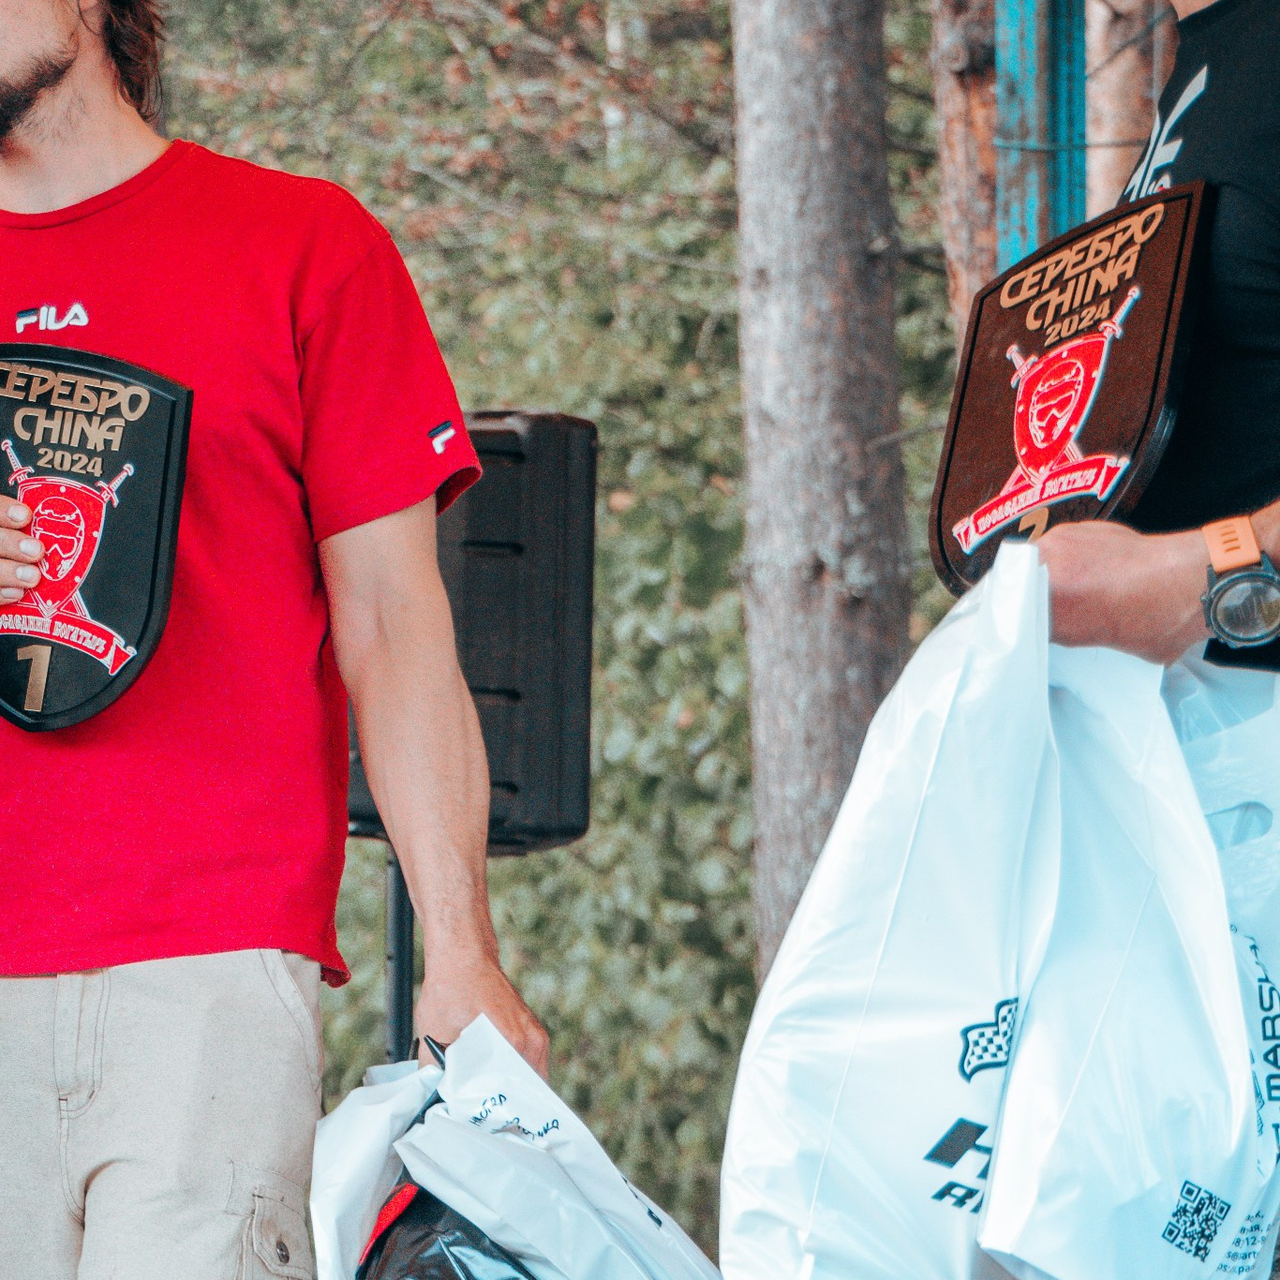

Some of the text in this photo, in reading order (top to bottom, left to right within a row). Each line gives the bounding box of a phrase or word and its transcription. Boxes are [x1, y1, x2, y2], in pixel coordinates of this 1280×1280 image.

[999, 202, 1166, 309] СЕРЕБРО
[1025, 243, 1143, 332] CHINA
[16, 303, 89, 333] FILA
[1043, 297, 1111, 348] 2024
[13, 406, 127, 453] CHINA
[36, 447, 104, 478] 2024
[17, 644, 53, 712] 1
